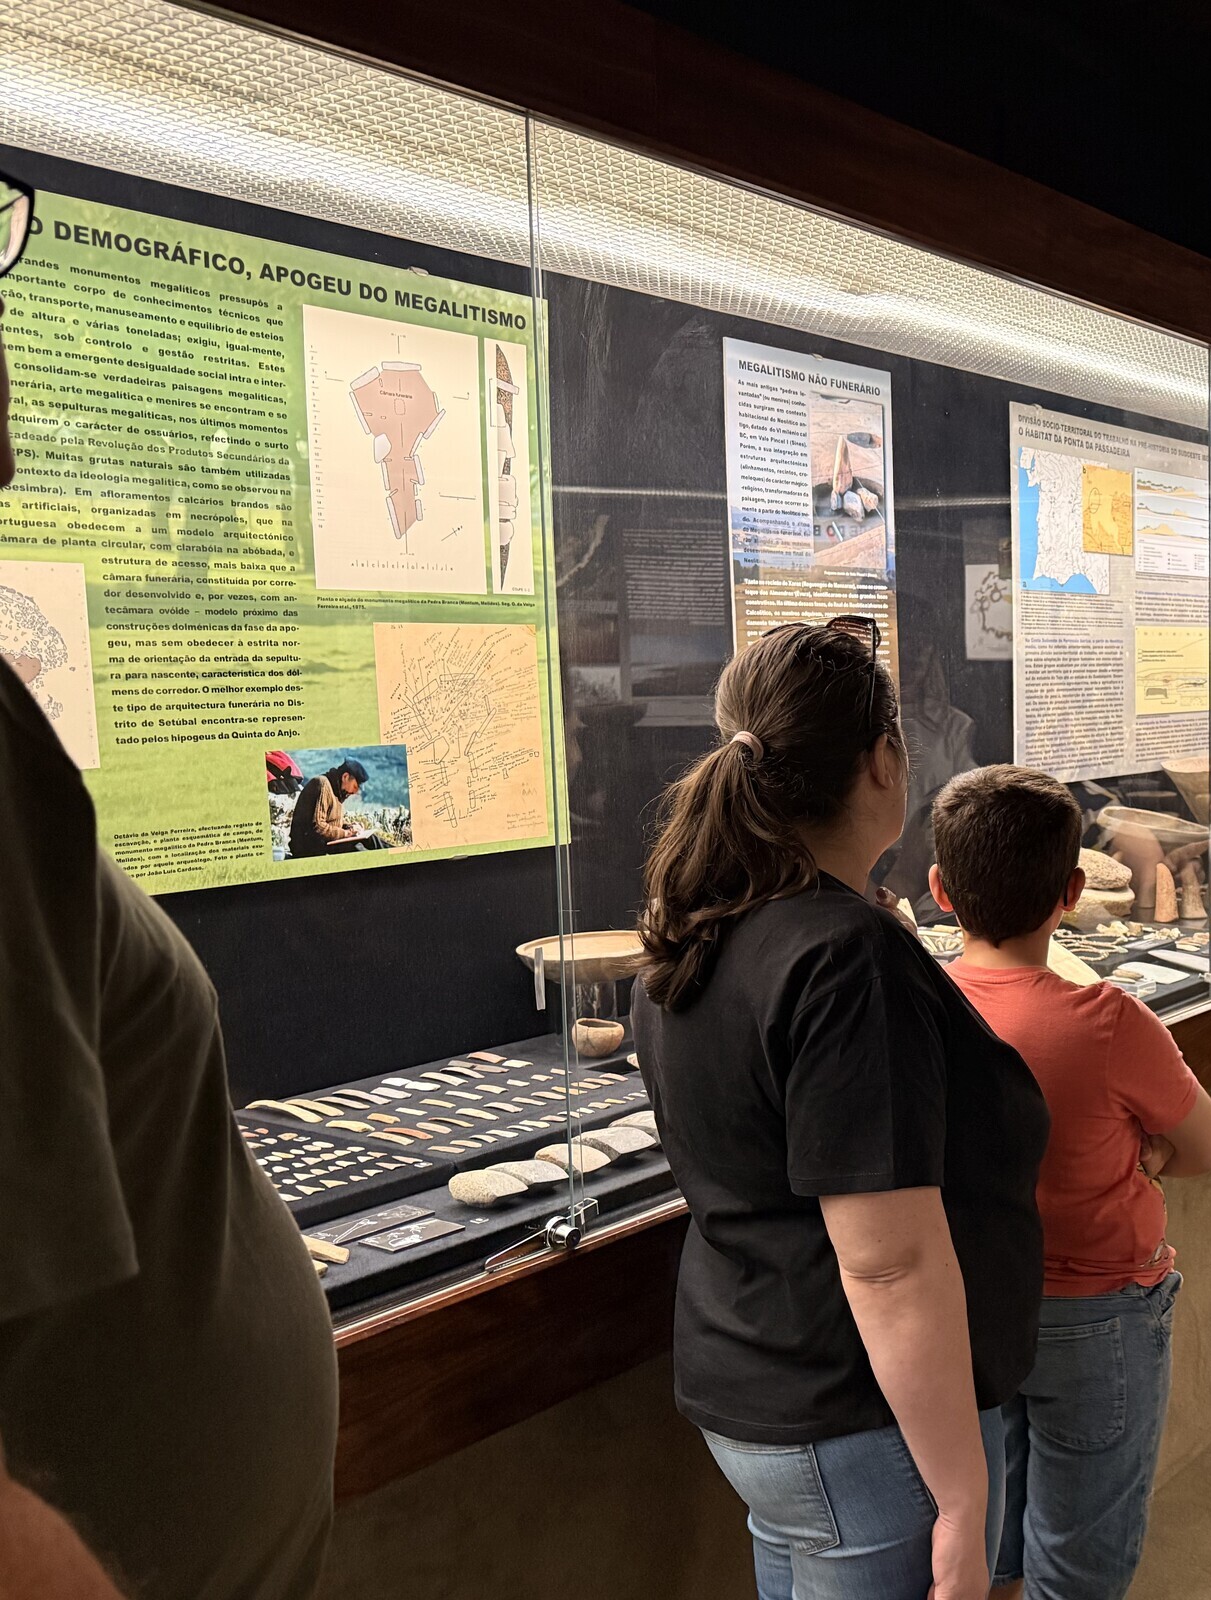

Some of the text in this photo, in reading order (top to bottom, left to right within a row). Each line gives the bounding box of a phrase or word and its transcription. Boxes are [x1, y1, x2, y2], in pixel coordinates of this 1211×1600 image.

[18, 256, 60, 270] randes
[69, 266, 141, 285] monumentos
[150, 281, 210, 298] megalíticos
[219, 293, 269, 308] pressupôs
[53, 220, 251, 281] DEMOGRÁFICO,
[259, 262, 351, 296] APOGEU
[359, 282, 388, 303] DO
[394, 289, 526, 330] MEGALITISMO
[13, 362, 286, 405] consolidam-se verdadeiras paisagens megalíticas,
[738, 359, 880, 396] MEGALITISMO NÃO FUNERÁRIO
[60, 436, 289, 465] pela Revolução dos Produtos Secundários da
[1018, 426, 1130, 457] O HABITAT DA PONTA DA PASSADEIRA
[16, 467, 61, 477] ontexto
[63, 469, 77, 479] da
[79, 470, 130, 484] ideologia
[131, 476, 190, 489] megalítica,
[192, 482, 219, 490] como
[234, 484, 278, 495] observou
[21, 501, 81, 514] artificiais,
[90, 506, 156, 517] organizadas
[190, 513, 250, 525] necrópoles,
[255, 518, 273, 526] que
[66, 520, 125, 532] obedecem
[176, 528, 214, 537] modelo
[223, 531, 294, 541] arquitectónico
[106, 622, 170, 632] construções
[230, 623, 242, 631] da
[243, 623, 264, 632] fase
[266, 624, 278, 632] da
[112, 704, 123, 712] te
[126, 703, 146, 713] tipo
[149, 702, 162, 711] de
[165, 701, 226, 712] arquitectura
[228, 699, 270, 708] funerária
[287, 698, 304, 706] Dis-
[114, 715, 305, 728] trito de Setúbal encontra-se represen-
[115, 728, 300, 745] tado pelos hipogeus da Quinta do Anjo.
